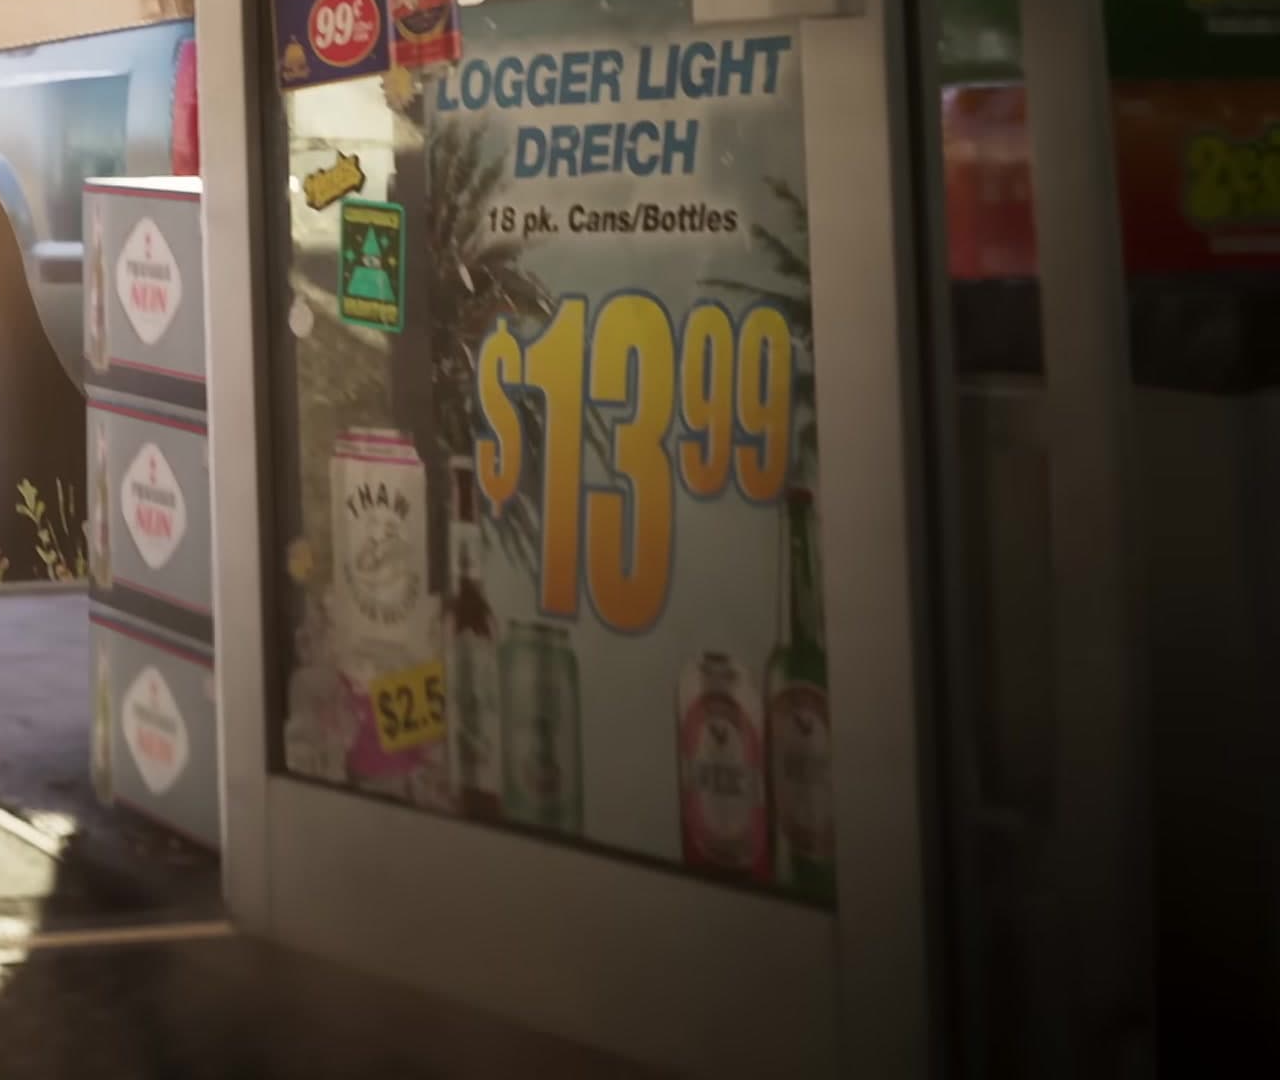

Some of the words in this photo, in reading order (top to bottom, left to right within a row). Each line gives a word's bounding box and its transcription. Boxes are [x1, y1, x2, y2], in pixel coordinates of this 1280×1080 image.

[436, 49, 624, 111] LOGGER
[636, 35, 792, 100] LIGHT
[514, 120, 700, 178] DREICH
[488, 206, 516, 233] 18
[523, 204, 559, 238] pk.
[568, 203, 739, 233] Cans/Bottles
